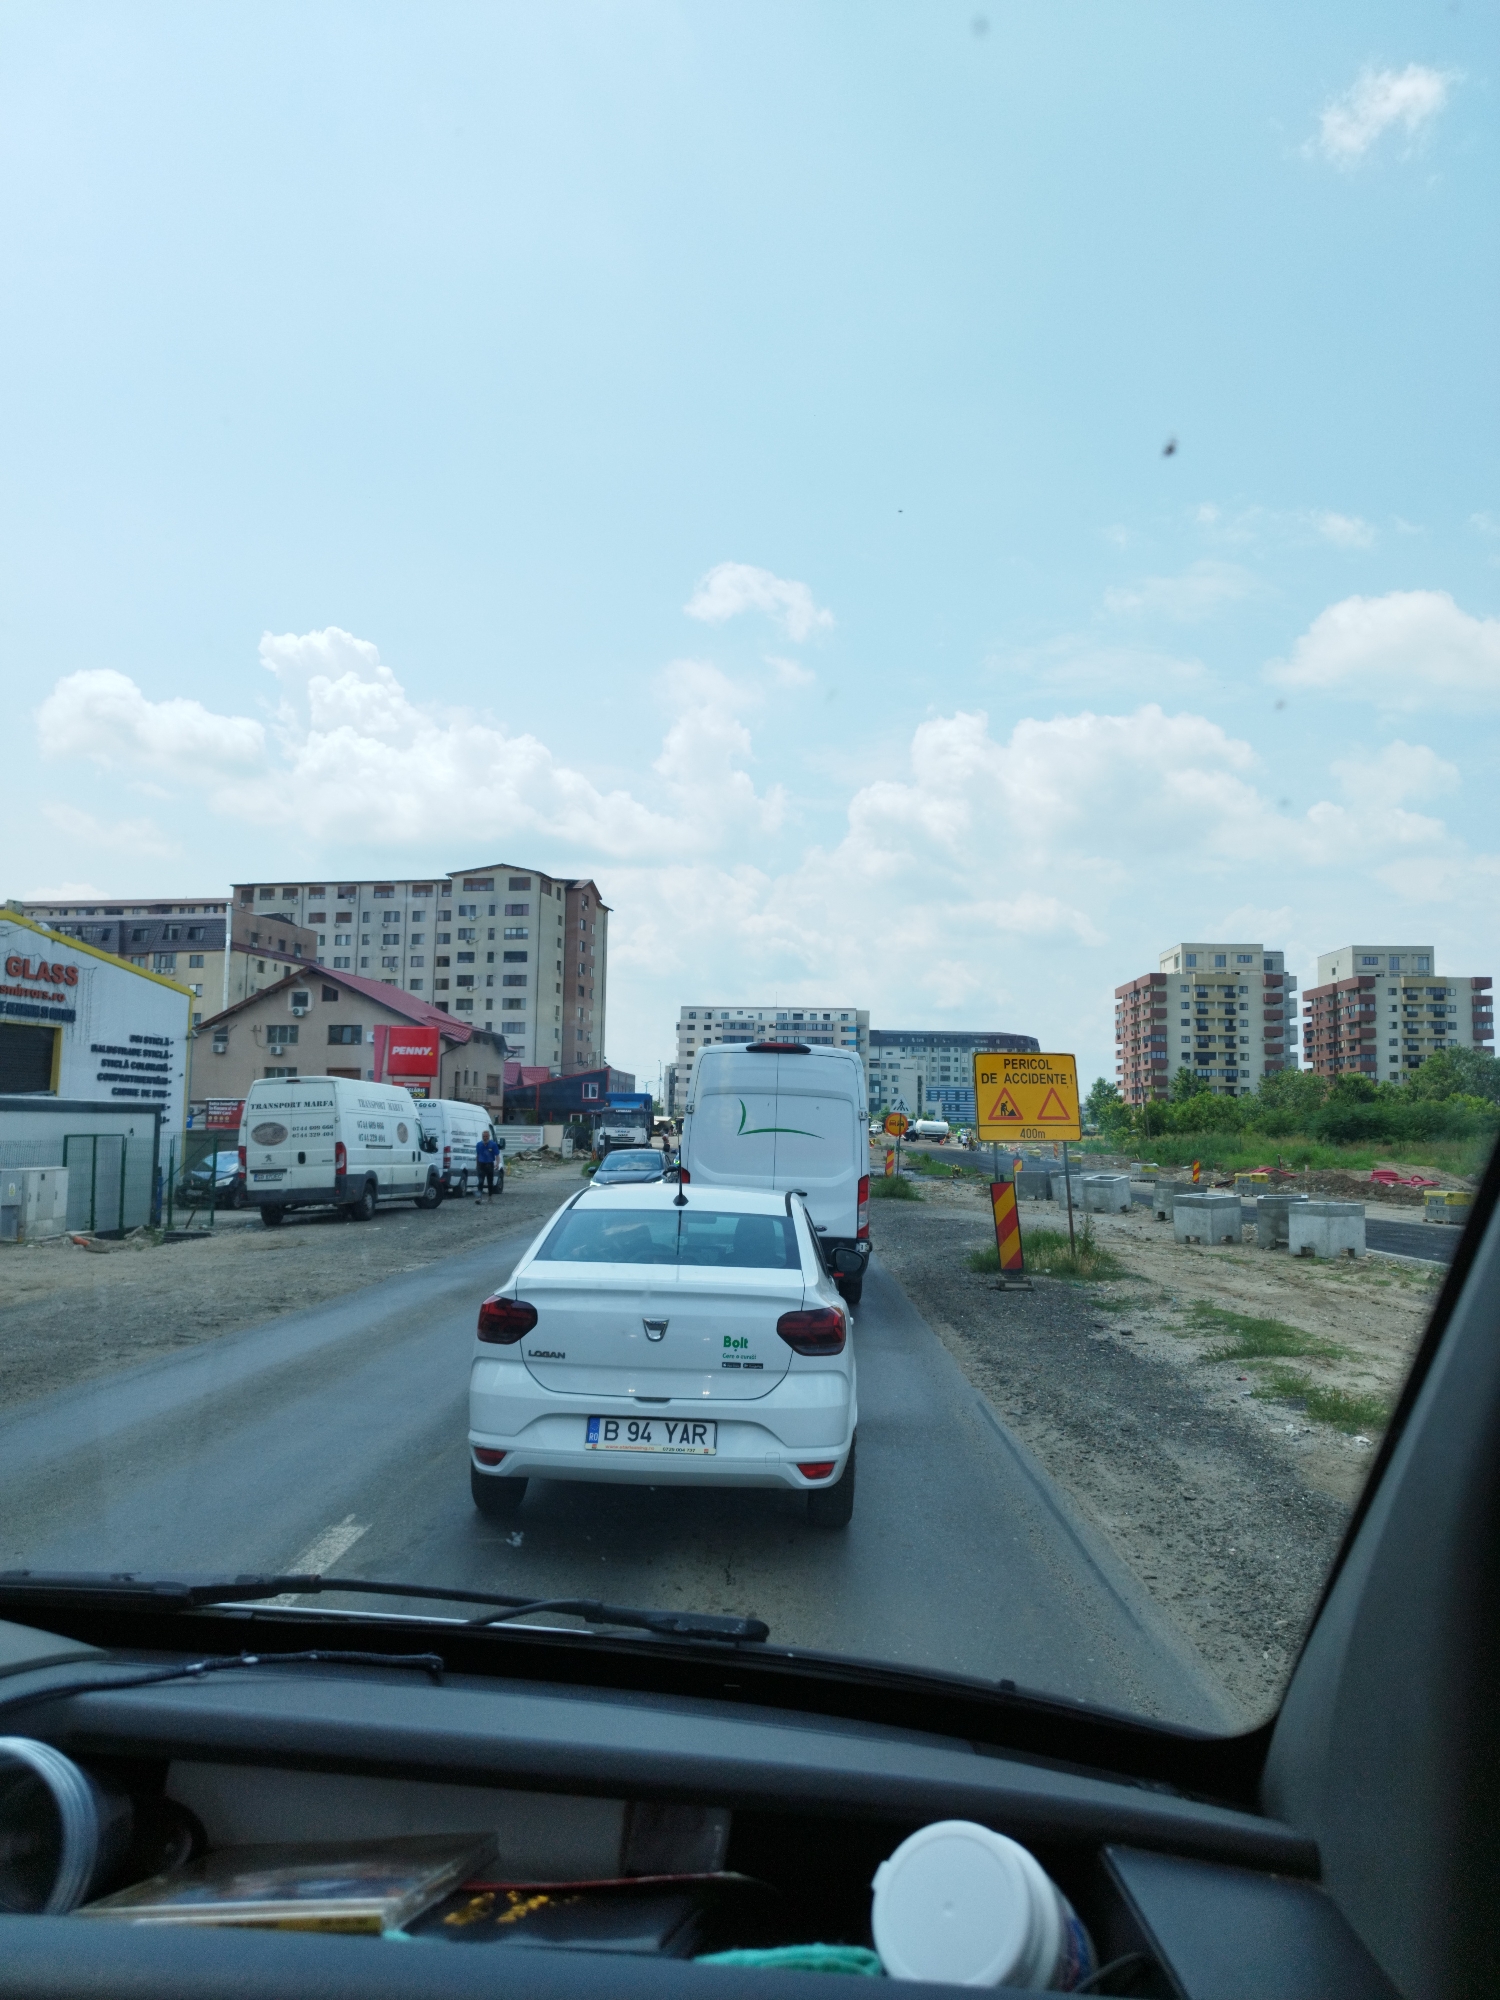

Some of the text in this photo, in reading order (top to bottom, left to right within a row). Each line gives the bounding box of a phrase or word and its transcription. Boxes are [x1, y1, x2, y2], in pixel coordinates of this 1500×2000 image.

[6, 956, 78, 986] GLASS
[1004, 1058, 1053, 1070] PERICOL
[981, 1073, 998, 1084] DE
[1004, 1073, 1067, 1085] ACCIDENTE
[251, 1100, 334, 1110] TRANSPORT MARFA
[358, 1099, 386, 1110] TRANSPORT
[1020, 1128, 1046, 1139] 400m
[723, 1335, 749, 1352] Bolt
[528, 1349, 566, 1360] LOGAN
[589, 1432, 600, 1442] RO
[604, 1420, 708, 1446] B 94 YAR
